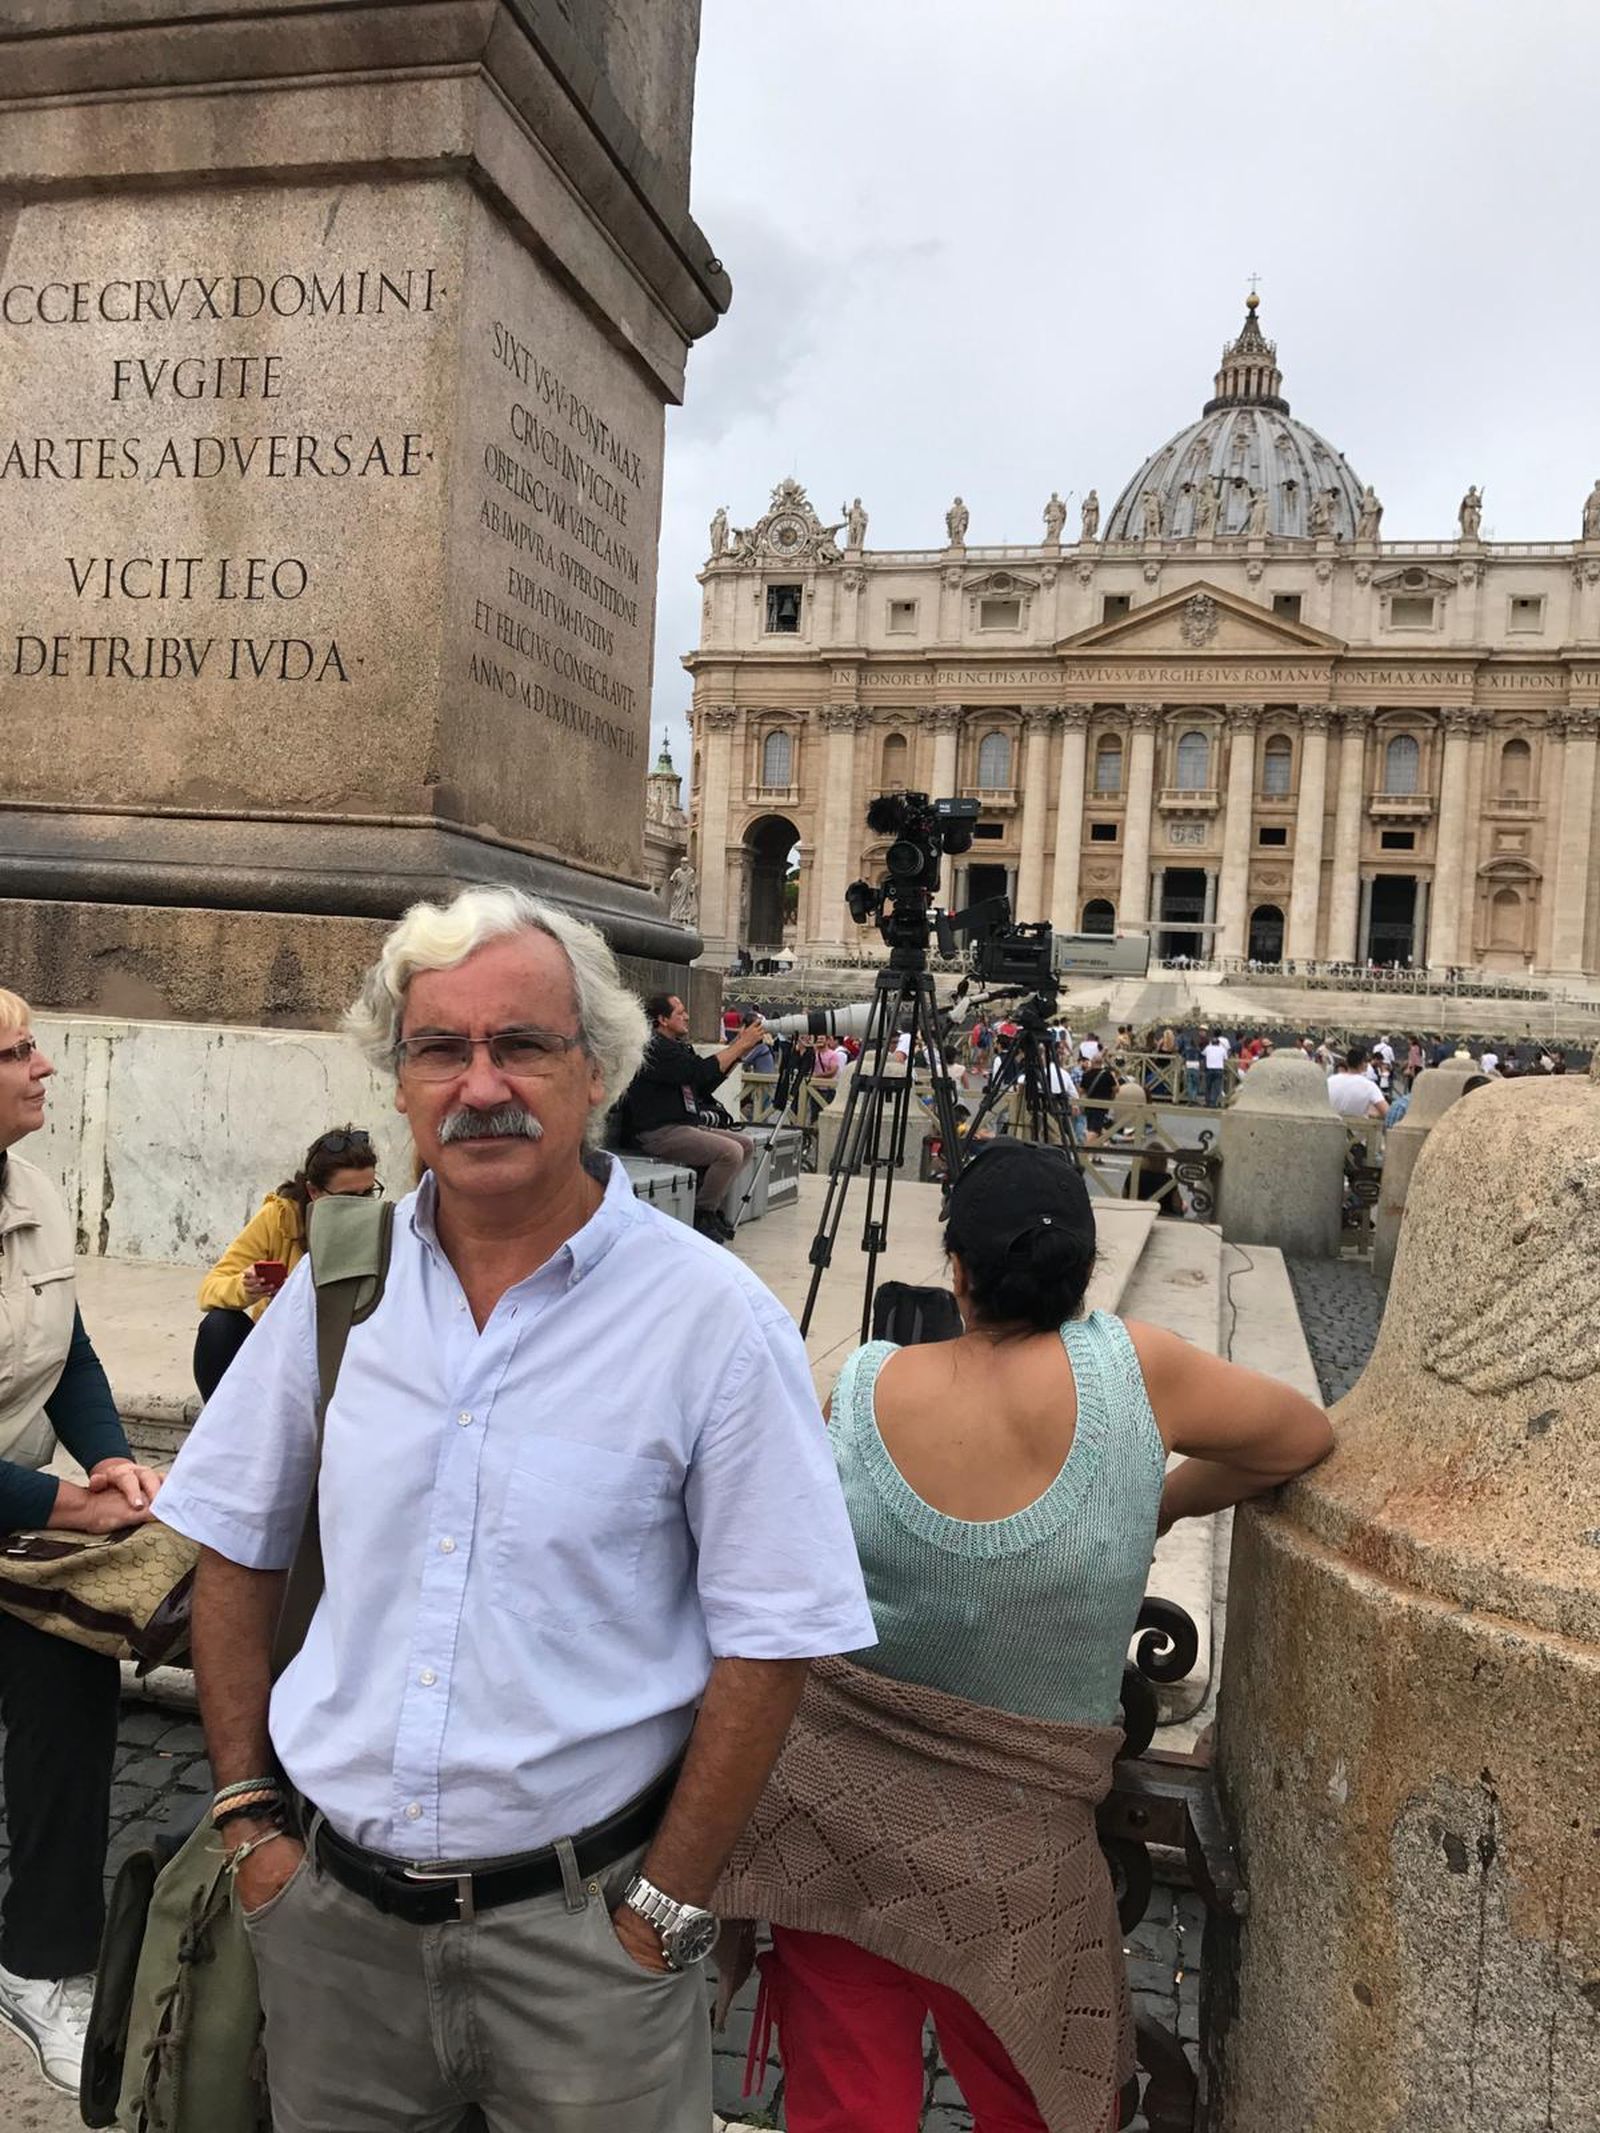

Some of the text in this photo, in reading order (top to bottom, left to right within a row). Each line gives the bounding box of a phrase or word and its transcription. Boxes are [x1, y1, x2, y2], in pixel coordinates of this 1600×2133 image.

[99, 277, 224, 323] CRVX
[111, 356, 283, 400] FVGITE
[485, 443, 640, 585] OBELISCVM VATICANVM
[65, 557, 308, 600] VICIT LEO
[475, 599, 492, 636] ET
[13, 635, 71, 677] DE
[79, 636, 215, 679] TRIBV
[833, 671, 852, 683] IN
[858, 672, 936, 686] HONOREM
[937, 671, 1016, 684] PRINCIPIS
[1245, 669, 1331, 682] ROMANVS
